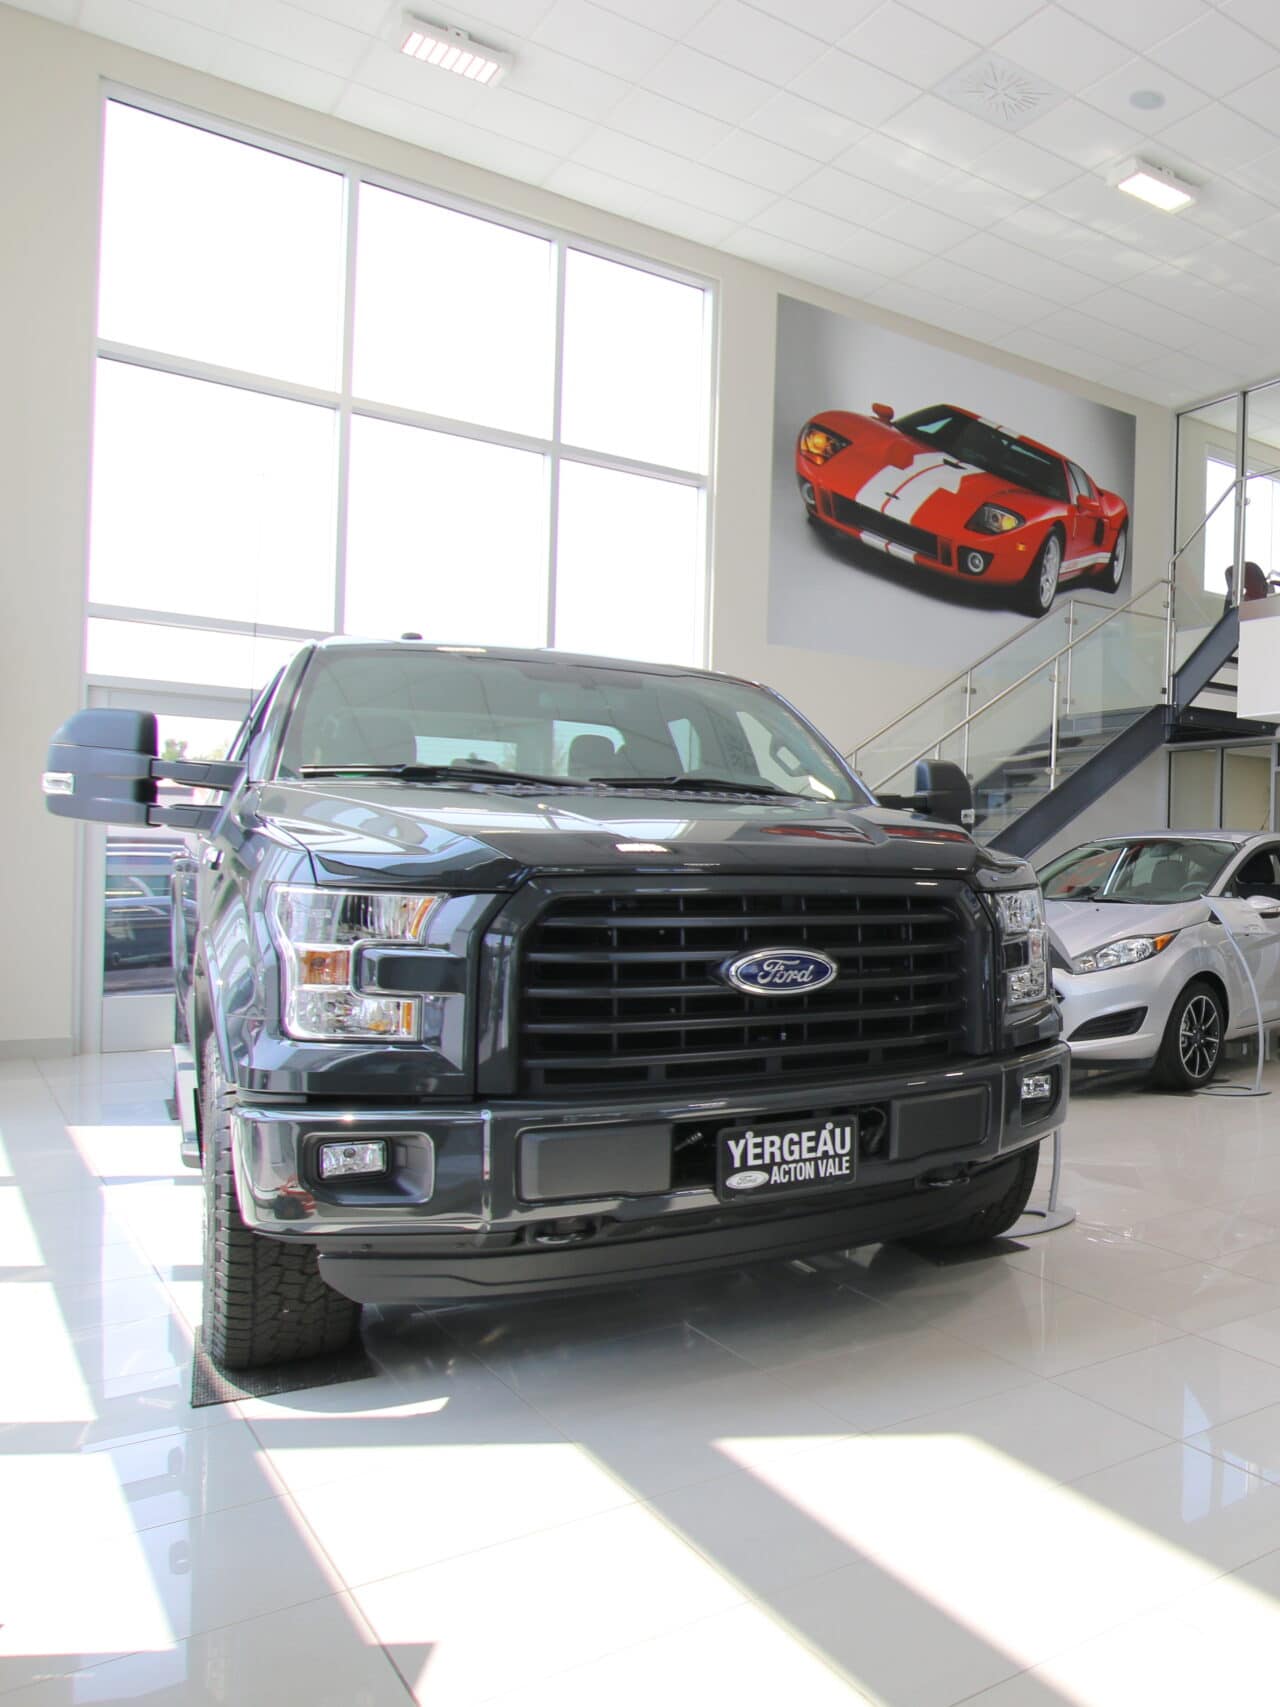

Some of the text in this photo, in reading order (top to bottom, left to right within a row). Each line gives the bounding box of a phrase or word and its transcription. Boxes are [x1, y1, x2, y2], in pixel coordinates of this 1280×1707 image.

[757, 959, 815, 984] Ford
[727, 1126, 852, 1169] YERGEAU
[770, 1156, 851, 1185] ACTON VALE
